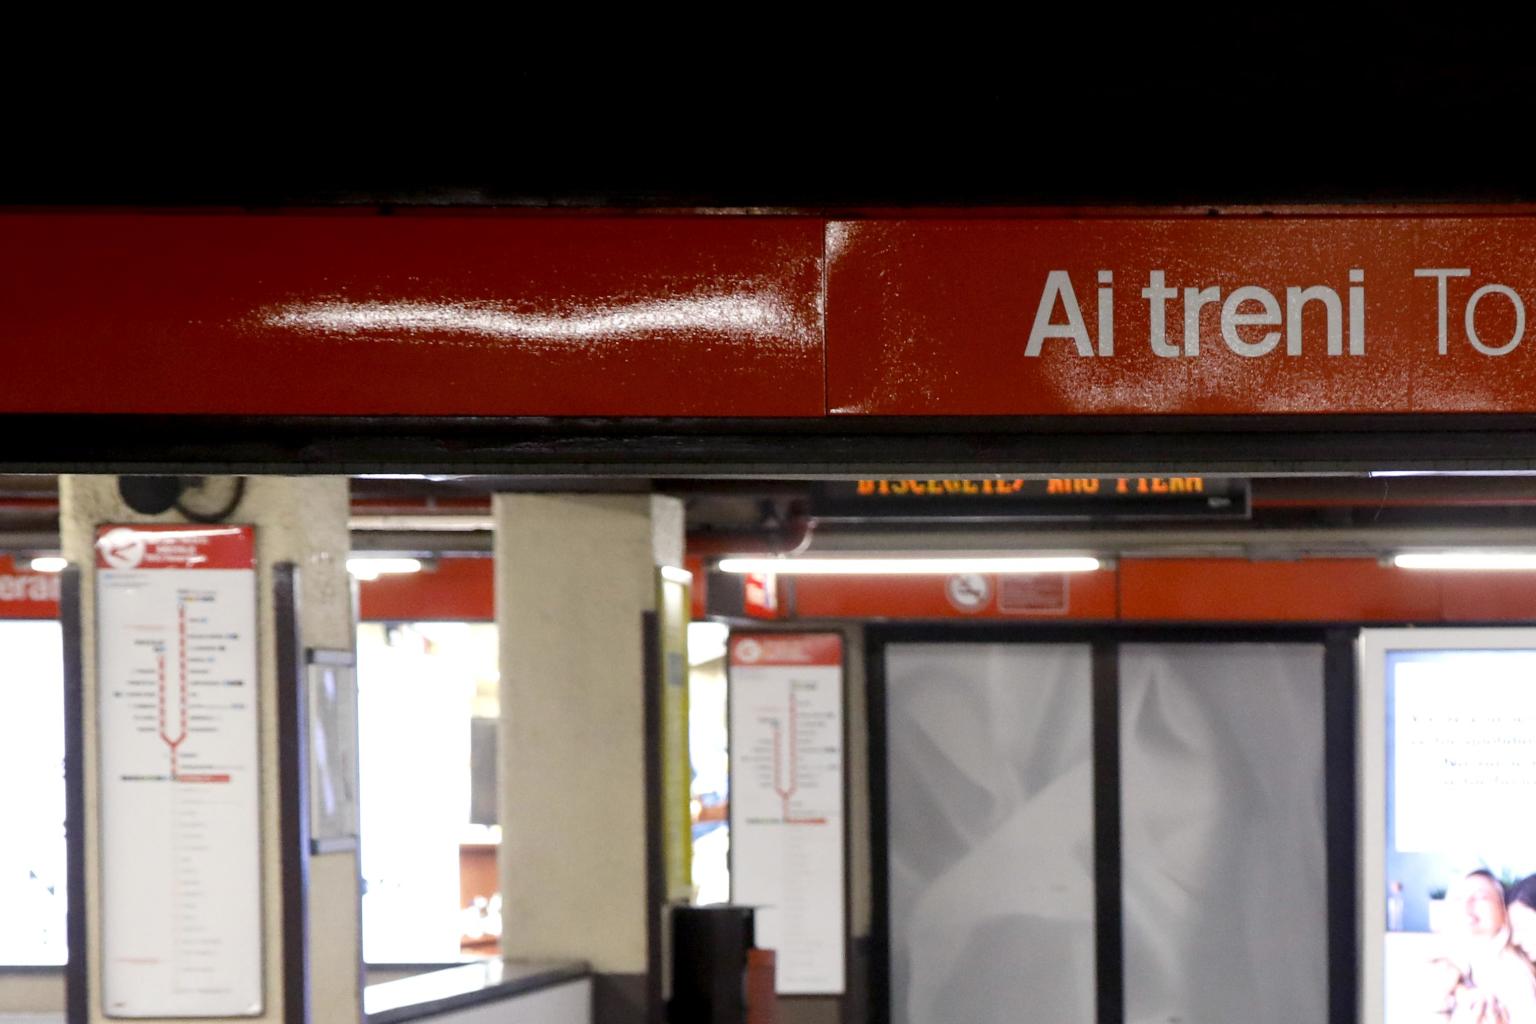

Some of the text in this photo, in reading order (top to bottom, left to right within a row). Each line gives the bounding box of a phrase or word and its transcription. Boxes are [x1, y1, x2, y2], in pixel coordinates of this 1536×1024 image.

[1024, 269, 1115, 358] Ai
[1142, 269, 1364, 358] treni
[1416, 268, 1525, 355] To
